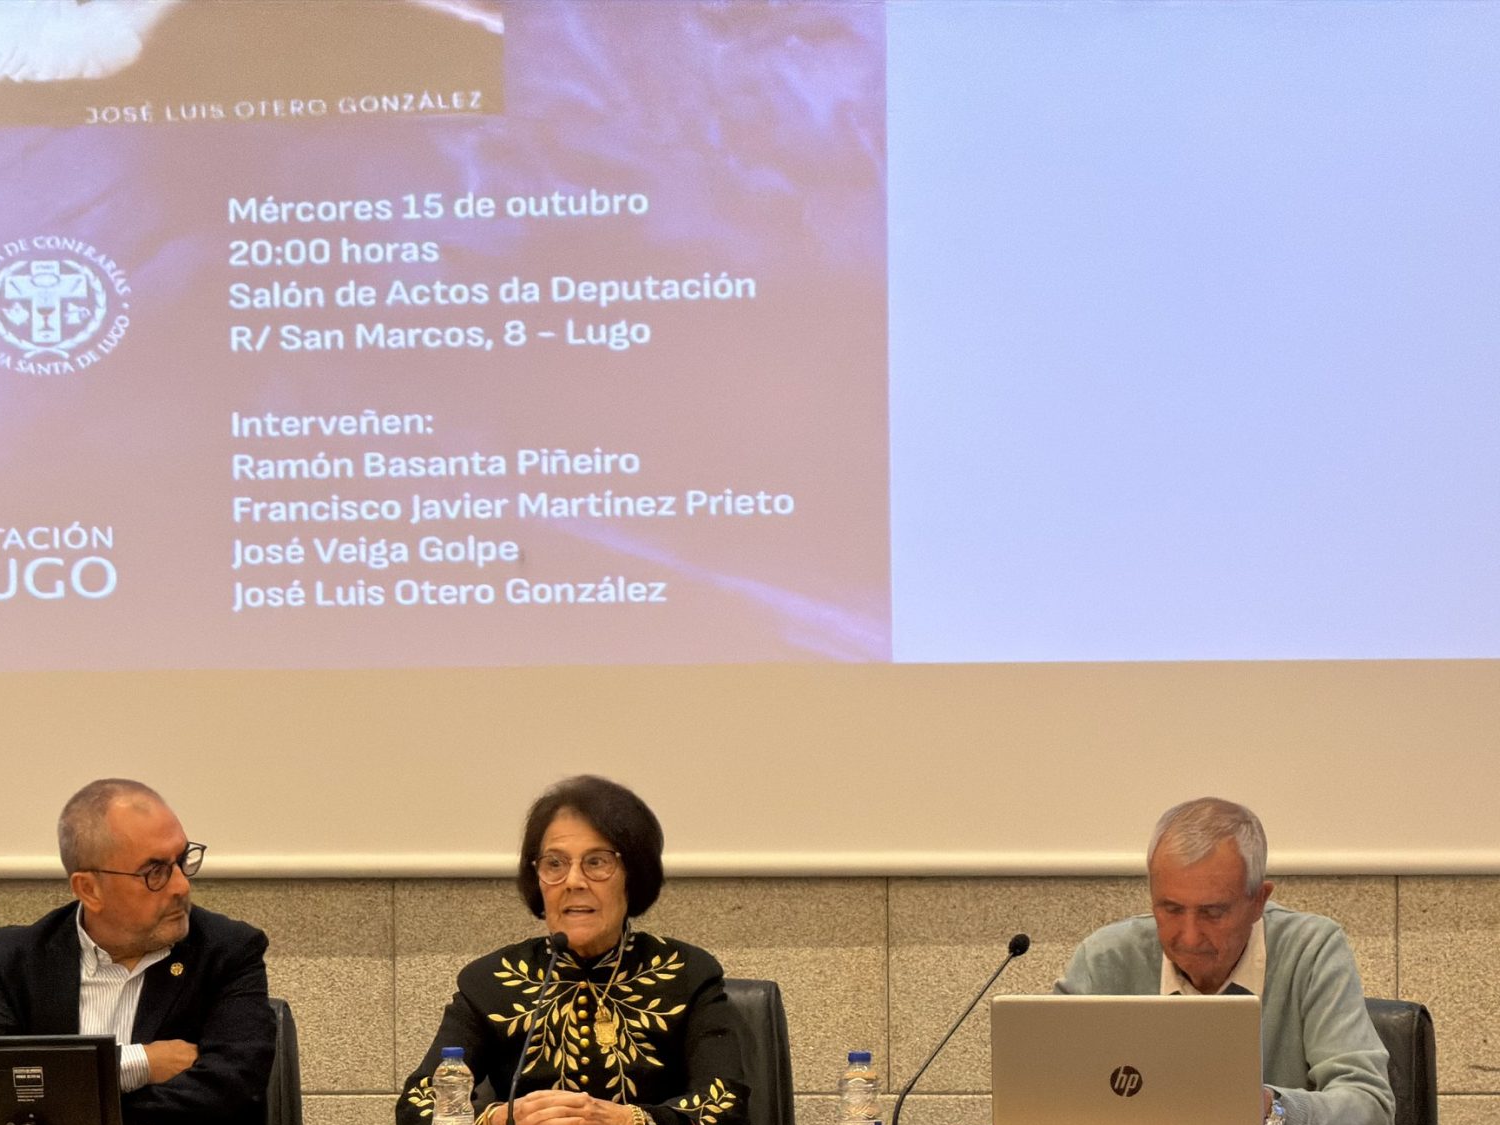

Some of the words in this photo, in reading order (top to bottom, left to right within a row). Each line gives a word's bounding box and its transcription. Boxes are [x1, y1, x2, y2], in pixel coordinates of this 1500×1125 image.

[86, 101, 152, 124] JOSÉ
[165, 104, 225, 121] LUIS
[234, 99, 327, 119] OTERO
[338, 91, 481, 113] GONZÁLEZ
[228, 196, 393, 223] Mércores
[402, 193, 444, 219] 15
[454, 188, 495, 219] de
[506, 188, 649, 218] outubro
[4, 239, 29, 256] DE
[229, 238, 330, 266] 20:00
[341, 237, 439, 264] horas
[229, 281, 325, 309] Salón
[335, 280, 376, 307] de
[385, 280, 489, 306] Actos
[499, 276, 540, 304] da
[551, 272, 756, 307] Deputación
[15, 358, 75, 375] SANTA
[76, 351, 100, 369] DE
[98, 315, 130, 353] LUGO
[231, 325, 271, 352] R/
[280, 325, 344, 351] San
[355, 323, 493, 351] Marcos,
[504, 320, 527, 346] 8
[567, 319, 651, 351] Lugo
[232, 409, 433, 437] Interveñen:
[232, 452, 354, 480] Ramón
[364, 452, 506, 478] Basanta
[518, 447, 640, 475] Piñeiro
[233, 494, 402, 522] Francisco
[410, 492, 509, 524] Javier
[518, 490, 676, 518] Martínez
[686, 488, 794, 515] Prieto
[232, 537, 305, 570] José
[313, 536, 409, 569] Veiga
[419, 535, 519, 568] Golpe
[233, 580, 305, 612] José
[315, 579, 385, 606] Luis
[395, 579, 495, 605] Otero
[506, 576, 667, 604] González
[1114, 1066, 1140, 1097] hp
